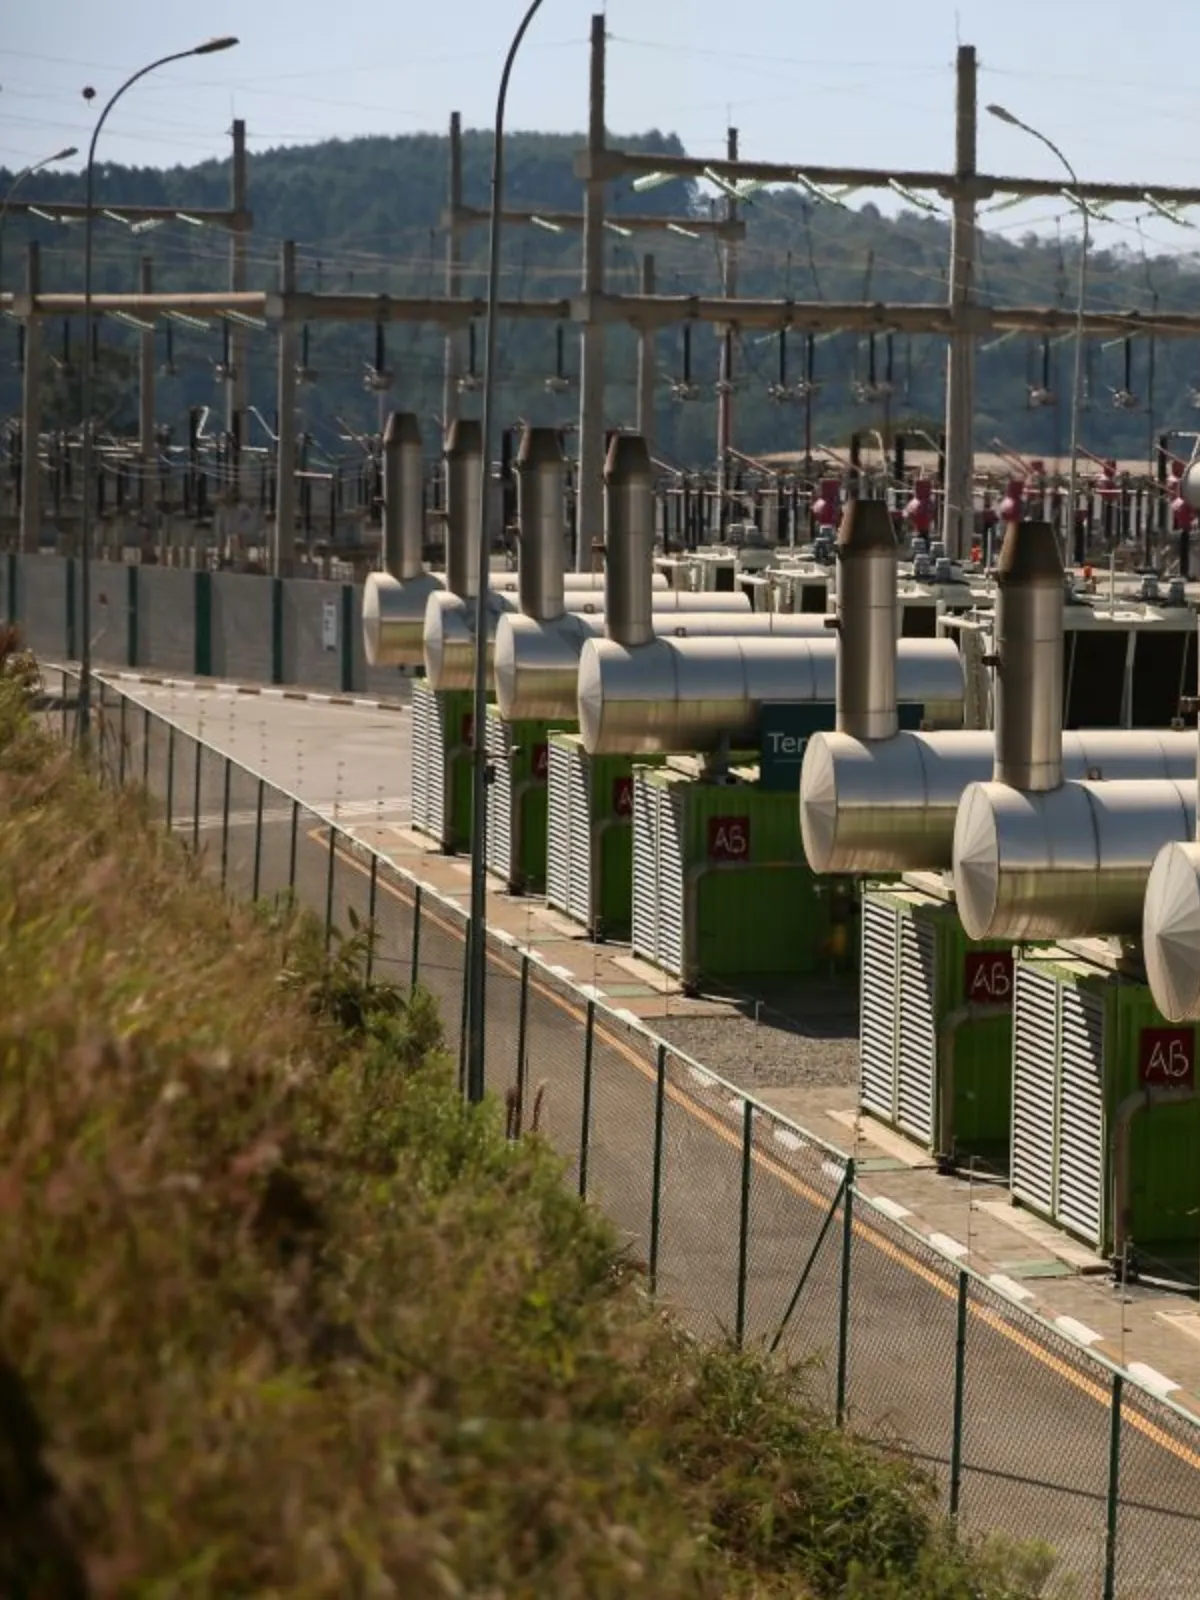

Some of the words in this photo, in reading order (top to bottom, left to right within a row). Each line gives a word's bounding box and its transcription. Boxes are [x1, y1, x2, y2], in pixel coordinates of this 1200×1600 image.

[713, 825, 746, 853] AB
[970, 961, 1010, 995] AB
[1145, 1040, 1189, 1078] AB
